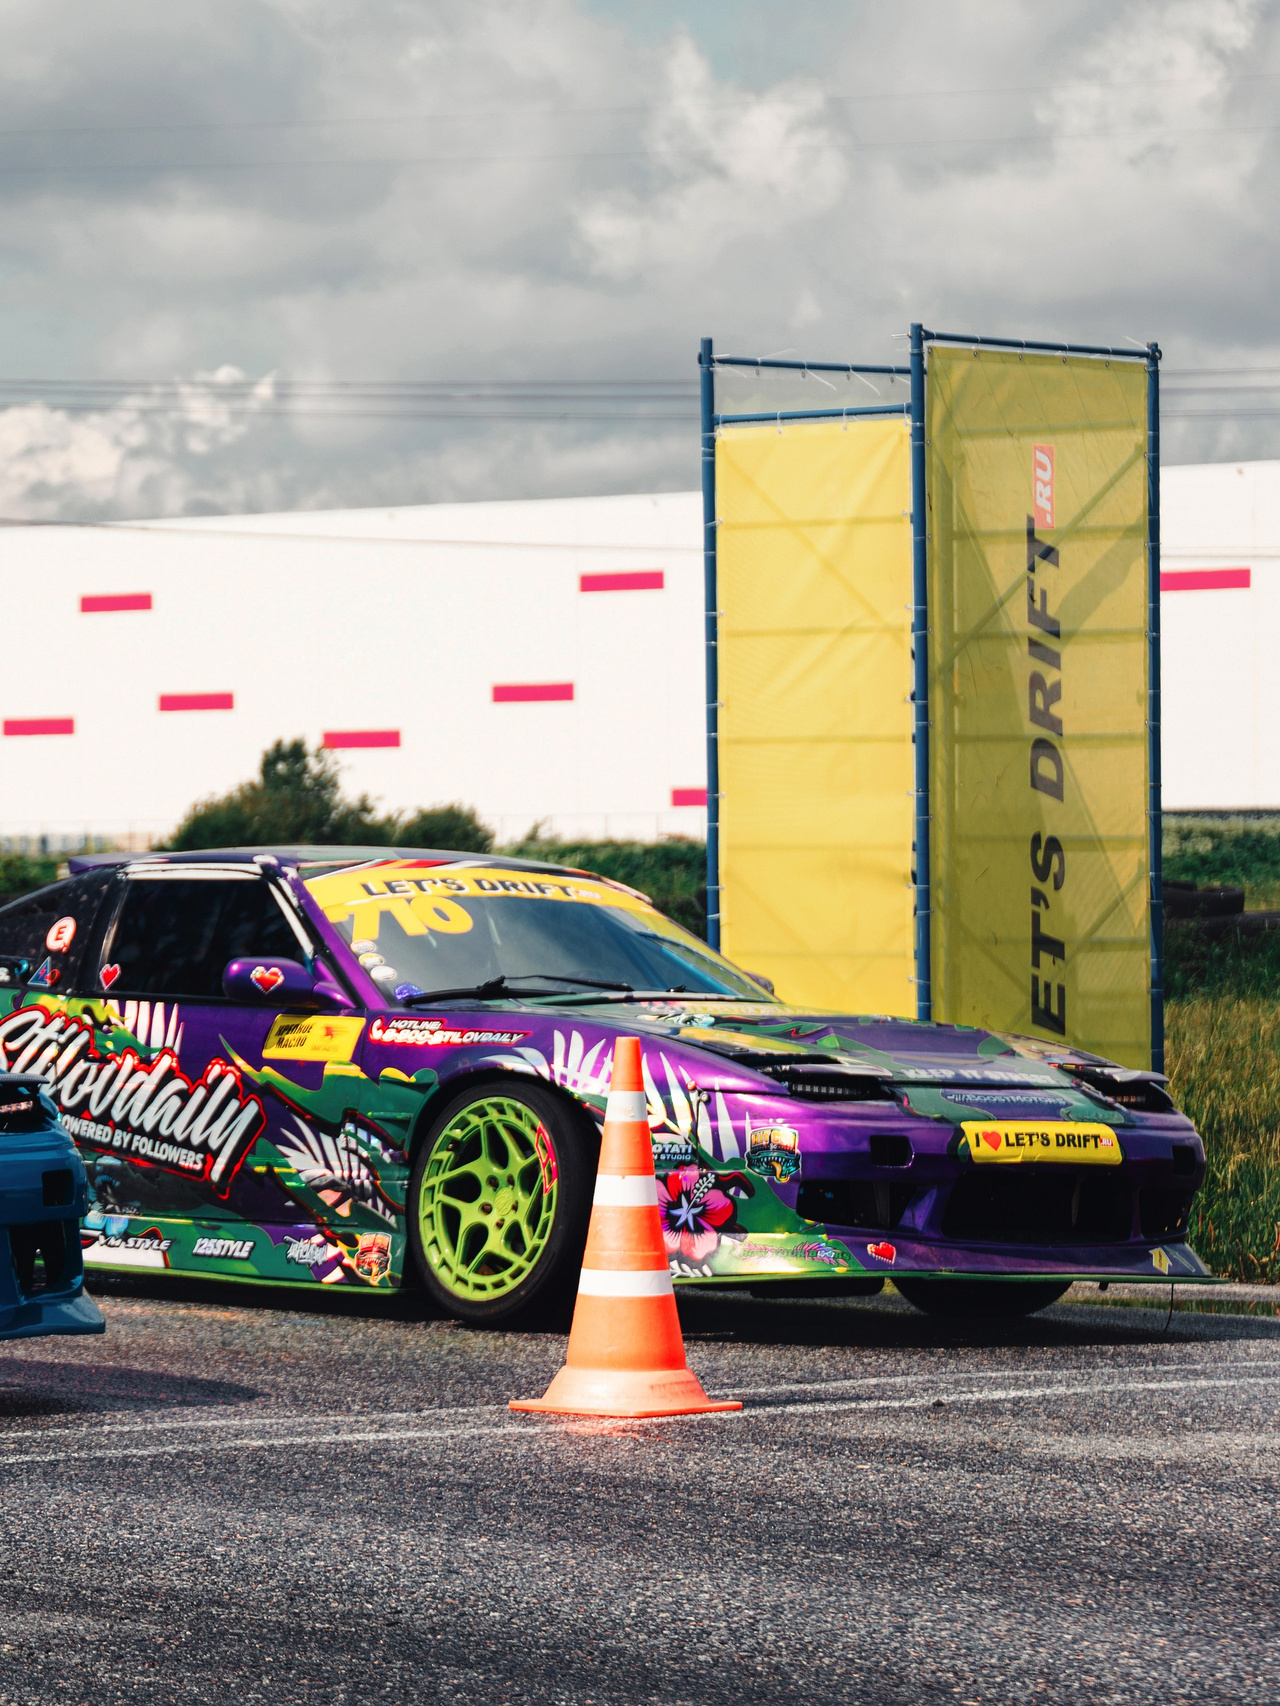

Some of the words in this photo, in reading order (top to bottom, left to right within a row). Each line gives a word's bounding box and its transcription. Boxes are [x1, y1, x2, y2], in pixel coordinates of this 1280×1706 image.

[361, 878, 469, 898] LET'S
[323, 895, 473, 941] 710
[1030, 831, 1066, 1036] ET'S
[61, 1115, 113, 1144] OWERED
[112, 1129, 132, 1150] BY
[131, 1134, 205, 1171] FOLLOWERS
[652, 1143, 692, 1155] OTATI
[975, 1133, 981, 1148] I
[1004, 1132, 1051, 1148] LET'S
[660, 1153, 691, 1161] STUDIO
[191, 1237, 257, 1260] 125STYLE
